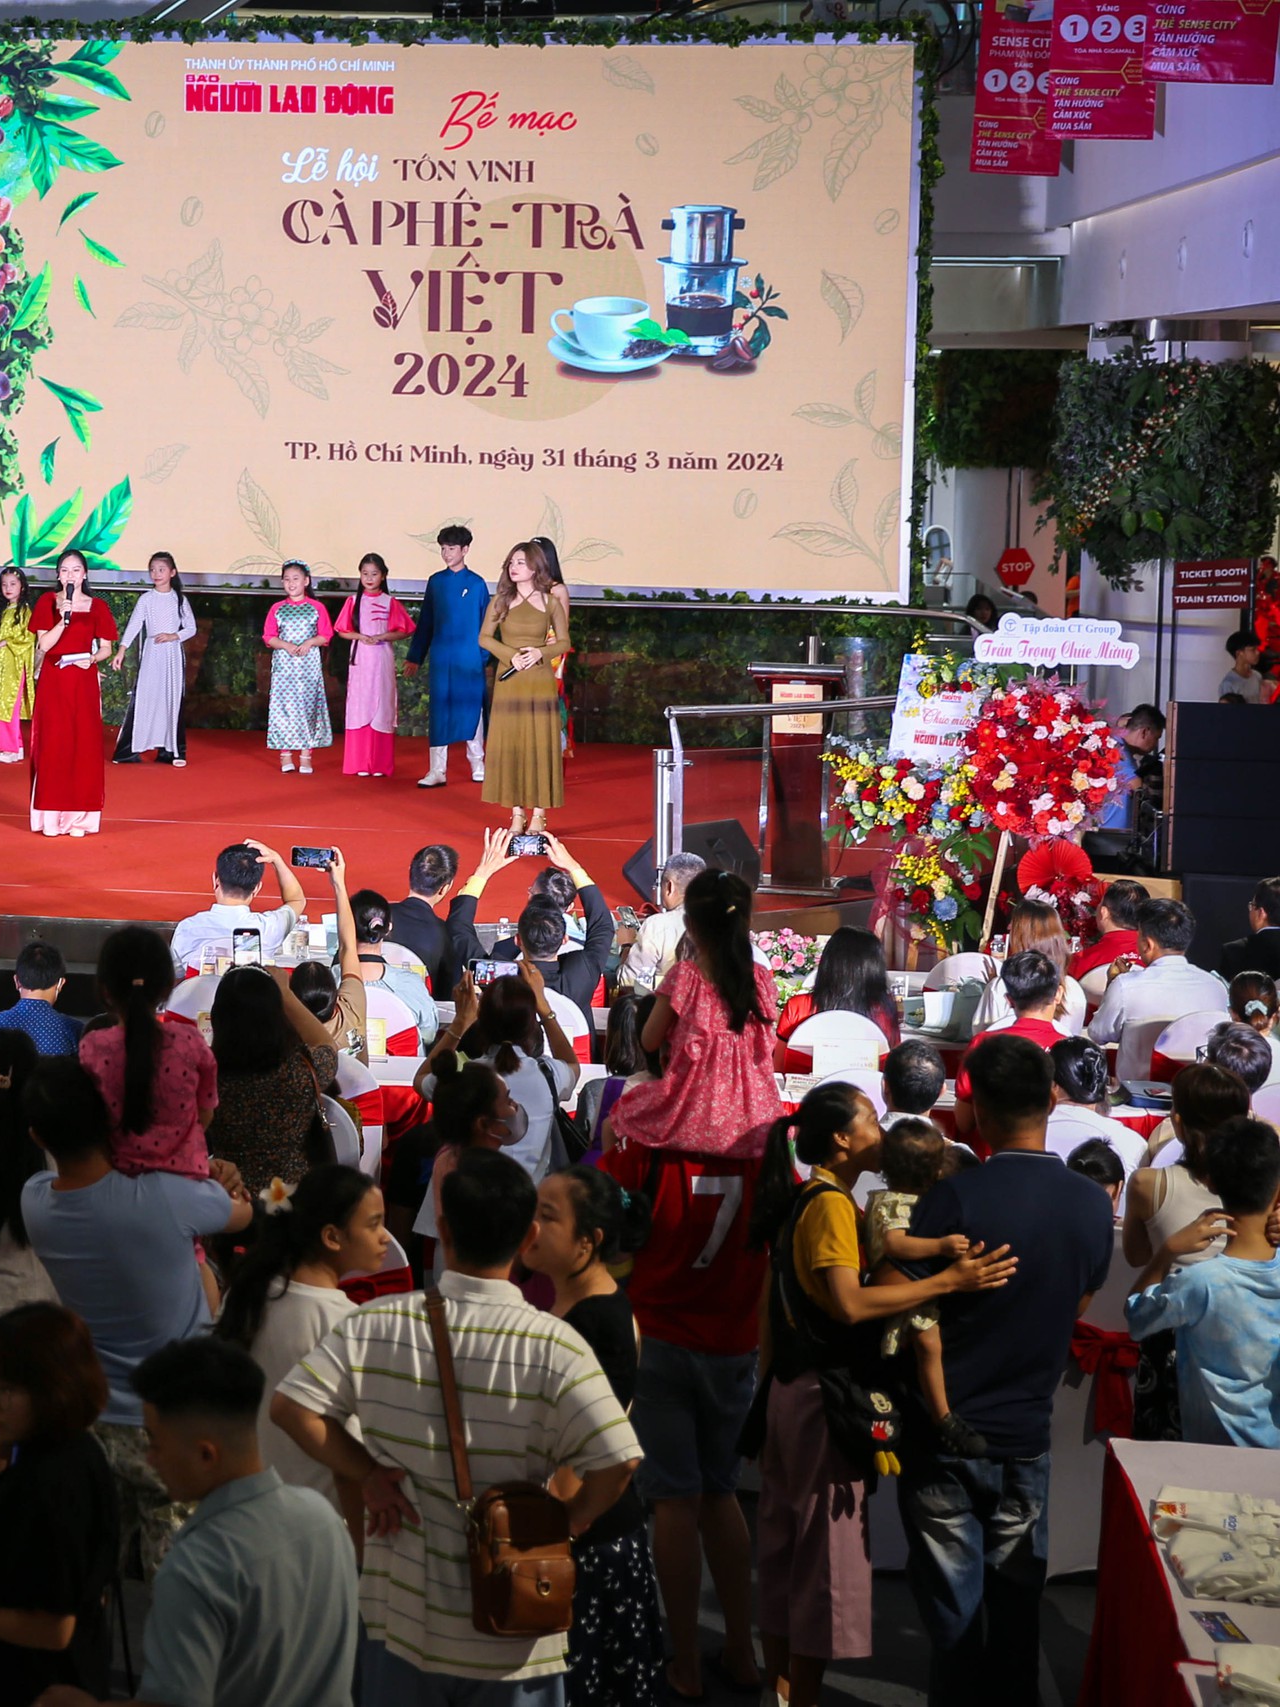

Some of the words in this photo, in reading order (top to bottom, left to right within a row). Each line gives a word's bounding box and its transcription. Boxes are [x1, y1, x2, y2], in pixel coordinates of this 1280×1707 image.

[1070, 21, 1078, 36] 1
[1100, 21, 1112, 36] 2
[1132, 21, 1144, 36] 3
[1178, 19, 1210, 30] SENSE
[1212, 20, 1238, 30] CITY
[992, 36, 1030, 48] SENSE
[1032, 38, 1052, 48] CIT
[184, 57, 226, 70] THÀNH
[228, 56, 246, 71] ỦY
[247, 57, 288, 71] THÀNH
[291, 57, 316, 72] PHỐ
[320, 58, 338, 72] HỒ
[340, 58, 361, 72] CHÍ
[362, 60, 396, 72] MINH
[1150, 62, 1174, 72] MUA
[992, 74, 1000, 87] 1
[1017, 76, 1027, 88] 2
[185, 81, 262, 112] NGƯỜI
[269, 84, 318, 114] LAO
[324, 82, 395, 115] ĐỘNG
[1074, 88, 1101, 97] SENSE
[1102, 88, 1121, 97] CITY
[439, 90, 500, 151] Bế
[508, 111, 578, 137] mạc
[1052, 122, 1072, 131] MUA
[282, 146, 330, 184] Lễ
[335, 147, 380, 188] hội
[392, 153, 457, 182] TÔN
[466, 160, 536, 183] VINH
[282, 188, 358, 246] CÀ
[361, 251, 564, 346] VIỆT
[392, 352, 530, 398] 2024
[284, 441, 321, 460] TP.
[328, 440, 358, 462] Hồ
[365, 442, 404, 462] Chí
[410, 444, 472, 466] Minh,
[478, 447, 534, 472] ngày
[542, 448, 566, 468] 31
[573, 447, 638, 473] tháng
[645, 451, 660, 470] 3
[668, 451, 718, 470] năm
[726, 452, 785, 472] 2024
[1001, 562, 1032, 573] STOP
[1180, 569, 1212, 579] TICKET
[1214, 568, 1248, 578] BOOTH
[1174, 595, 1204, 604] TRAIN
[1206, 594, 1247, 604] STATION
[1022, 624, 1041, 636] Tập
[1068, 624, 1084, 634] CT
[1085, 624, 1116, 635] Group
[1018, 640, 1057, 662] Trọng
[1060, 640, 1092, 660] Chúc
[691, 1175, 743, 1269] 7
